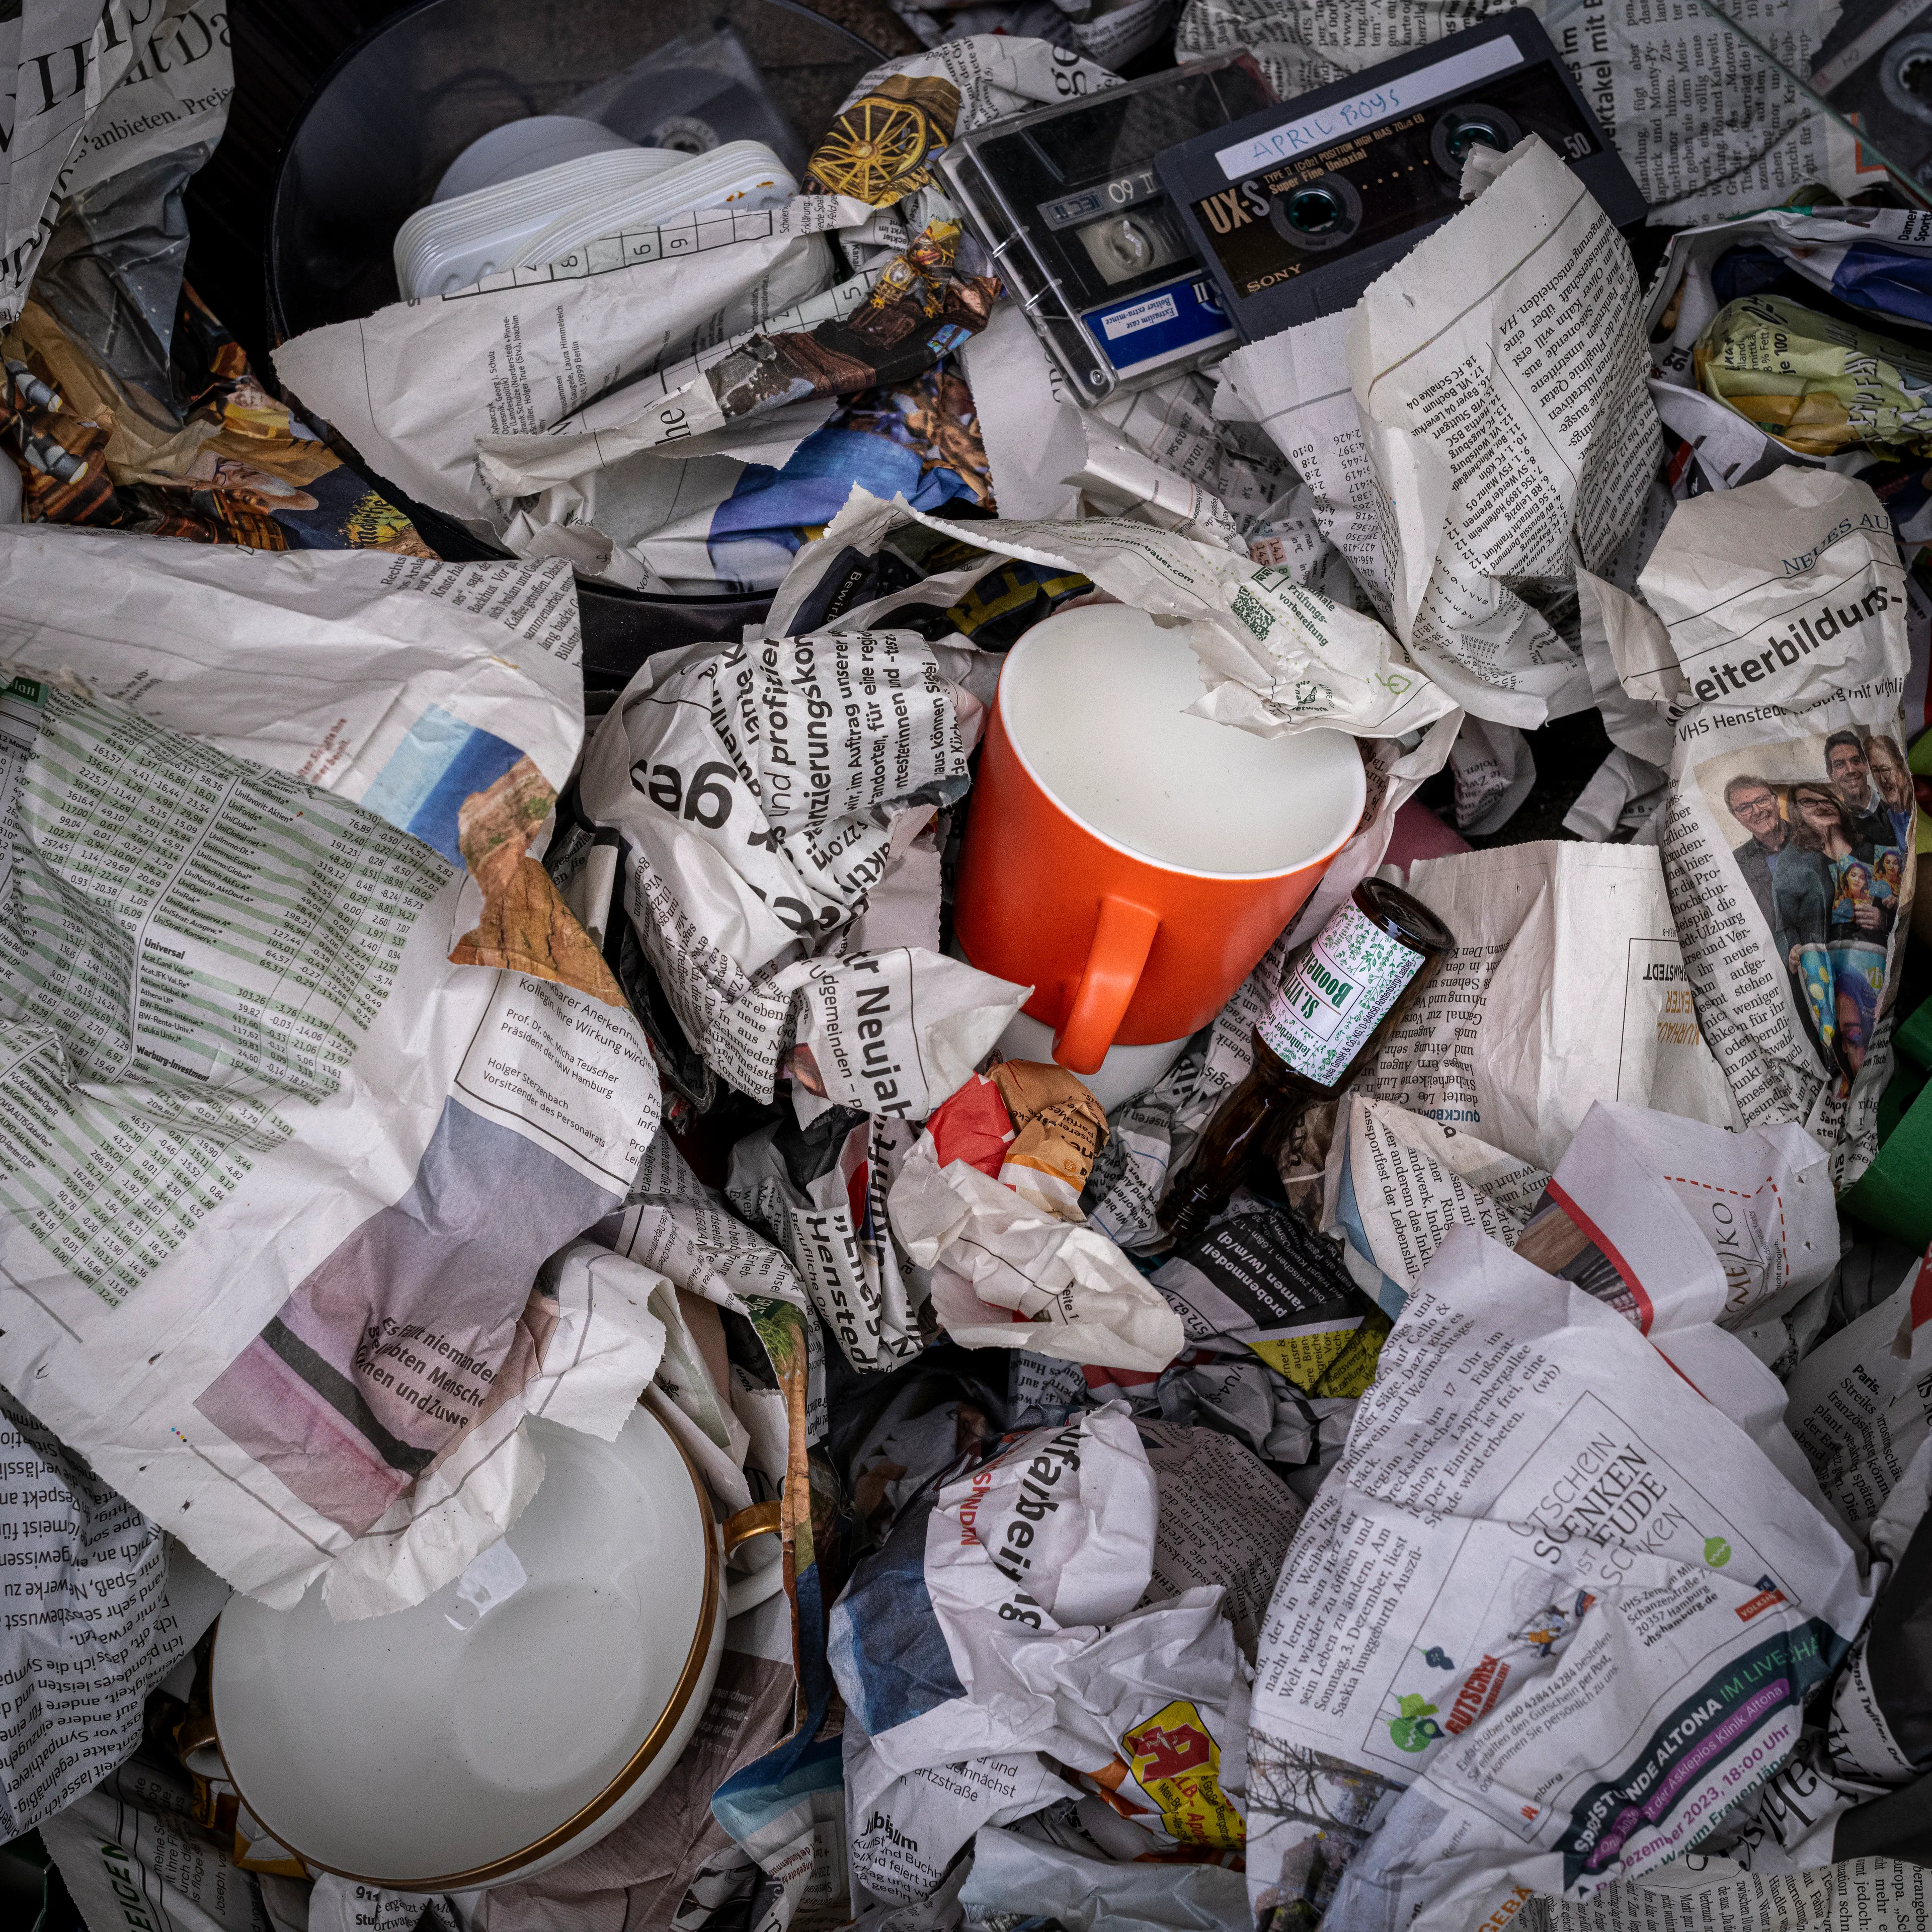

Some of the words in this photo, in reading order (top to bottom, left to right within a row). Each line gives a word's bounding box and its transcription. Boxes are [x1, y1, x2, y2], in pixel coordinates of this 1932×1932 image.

[1253, 119, 1334, 158] APRIL
[1264, 171, 1284, 184] TYPE
[1319, 142, 1354, 164] POSITION
[1353, 135, 1373, 148] HIGH
[1374, 127, 1393, 141] BIAS
[1413, 113, 1425, 125] EQ
[1563, 132, 1591, 158] 50
[1268, 179, 1300, 195] Super
[1302, 167, 1325, 182] Fine
[1325, 149, 1367, 172] Uniaxial
[1107, 179, 1134, 204] 60
[1201, 180, 1270, 234] UX-S
[1246, 263, 1302, 293] SONY
[1517, 261, 1575, 314] entscheiden.
[555, 305, 568, 349] Himmelreich
[1105, 306, 1146, 327] extra-mince
[1125, 317, 1140, 330] case
[1141, 307, 1175, 324] Extraslim
[1498, 315, 1519, 336] HA
[1533, 304, 1557, 329] über
[1556, 299, 1584, 328] Kahn
[487, 351, 497, 373] Schulz
[564, 351, 573, 371] Laura
[572, 341, 582, 361] Berlin
[1463, 355, 1477, 368] 18.
[1512, 346, 1533, 368] erst
[1568, 339, 1608, 375] Fluglinie
[576, 363, 587, 386] 10999
[1451, 367, 1465, 380] FC
[1470, 365, 1485, 377] 17.
[1522, 358, 1543, 379] aus.
[1530, 340, 1585, 394] umstrittene
[522, 381, 532, 405] Holger
[1419, 374, 1453, 400] Schalke
[1458, 378, 1473, 391] VfL
[1539, 376, 1570, 408] Qatar
[1547, 373, 1597, 421] lukrativen
[1406, 399, 1420, 410] 04
[1422, 389, 1459, 414] Bochum
[1458, 390, 1480, 408] Bayer
[1471, 398, 1486, 413] VfB
[1432, 412, 1472, 439] Stuttgart
[1464, 408, 1490, 432] Hertha
[1558, 405, 1589, 434] ausge-
[1445, 431, 1466, 447] BSC
[1493, 475, 1517, 502] Werder
[1505, 490, 1522, 507] 1899
[1531, 482, 1543, 494] RB
[1463, 499, 1493, 528] Bremen
[1468, 505, 1507, 540] Hoffenheim
[1504, 496, 1533, 522] Leipzig
[1278, 592, 1330, 648] vorbereitung
[836, 639, 853, 699] unserer
[859, 667, 877, 696] eine
[867, 701, 883, 732] für
[930, 697, 944, 750] können
[844, 703, 862, 769] Auftrag
[1677, 719, 1711, 744] VHS
[764, 771, 792, 817] und
[330, 839, 358, 857] 191,23
[144, 937, 186, 960] Universal
[1725, 927, 1751, 945] Ver-
[1723, 942, 1760, 966] neues
[236, 988, 266, 1005] 303,26
[1441, 978, 1480, 989] Sehens
[1734, 972, 1774, 998] stehen
[1301, 992, 1320, 1019] St.
[1732, 986, 1780, 1016] weniger
[555, 1006, 574, 1026] Ihre
[575, 1019, 622, 1055] Wirkung
[1322, 1064, 1336, 1081] Rola
[1333, 1052, 1347, 1070] GmbH
[1360, 1006, 1380, 1031] D-84056
[1376, 959, 1413, 1007] Rottenburg/Laaber
[506, 1008, 530, 1026] Prof.
[532, 1020, 542, 1034] Dr.
[542, 1030, 554, 1047] oec.
[555, 1041, 575, 1063] Micha
[577, 1059, 619, 1083] Teuscher
[1274, 1021, 1311, 1057] feinherber
[1385, 1043, 1408, 1054] sehr.
[136, 1044, 210, 1082] Warburg-Investment
[501, 1022, 544, 1052] Präsident
[543, 1047, 555, 1061] der
[554, 1057, 570, 1075] HAW
[572, 1071, 614, 1099] Hamburg
[488, 1057, 521, 1078] Holger
[521, 1074, 569, 1110] Sterzenbach
[483, 1071, 538, 1107] Vorsitzender
[540, 1103, 555, 1116] des
[556, 1113, 606, 1147] Personalrats
[1442, 1092, 1478, 1106] deutet
[130, 1114, 151, 1133] 46,53
[90, 1149, 114, 1173] 266,93
[99, 1140, 124, 1162] 135,05
[1390, 1150, 1414, 1208] anderem
[1408, 1209, 1422, 1232] das
[1460, 1205, 1476, 1227] mit
[1383, 1185, 1396, 1206] der
[1390, 1209, 1420, 1279] Lebenshil-
[138, 1251, 158, 1268] 16,99
[791, 1210, 820, 1293] Berufliche
[1216, 1230, 1268, 1281] (w/m/d)
[1200, 1242, 1287, 1319] probenmodell
[1452, 1344, 1532, 1441] Lappenbergallee
[1851, 1363, 1881, 1396] Paris.
[1839, 1377, 1878, 1415] Streiks
[1481, 1410, 1526, 1459] erbeten.
[1346, 1573, 1396, 1641] Dezember,
[1635, 1607, 1665, 1636] 20357
[1666, 1584, 1711, 1619] Hamburg
[38, 1679, 90, 1693] leisten
[1314, 1658, 1351, 1711] Sonntag,
[1331, 1670, 1362, 1718] Saskia
[58, 1713, 111, 1725] andere
[115, 1701, 138, 1716] auf
[1715, 1714, 1746, 1746] Klinik
[1745, 1685, 1785, 1719] Altona
[1658, 1698, 1725, 1767] ALTONA
[991, 1761, 1018, 1778] und
[1683, 1786, 1726, 1829] 2023,
[1762, 1723, 1792, 1752] Uhr
[62, 1772, 93, 1800] lasse
[890, 1860, 920, 1885] feiert
